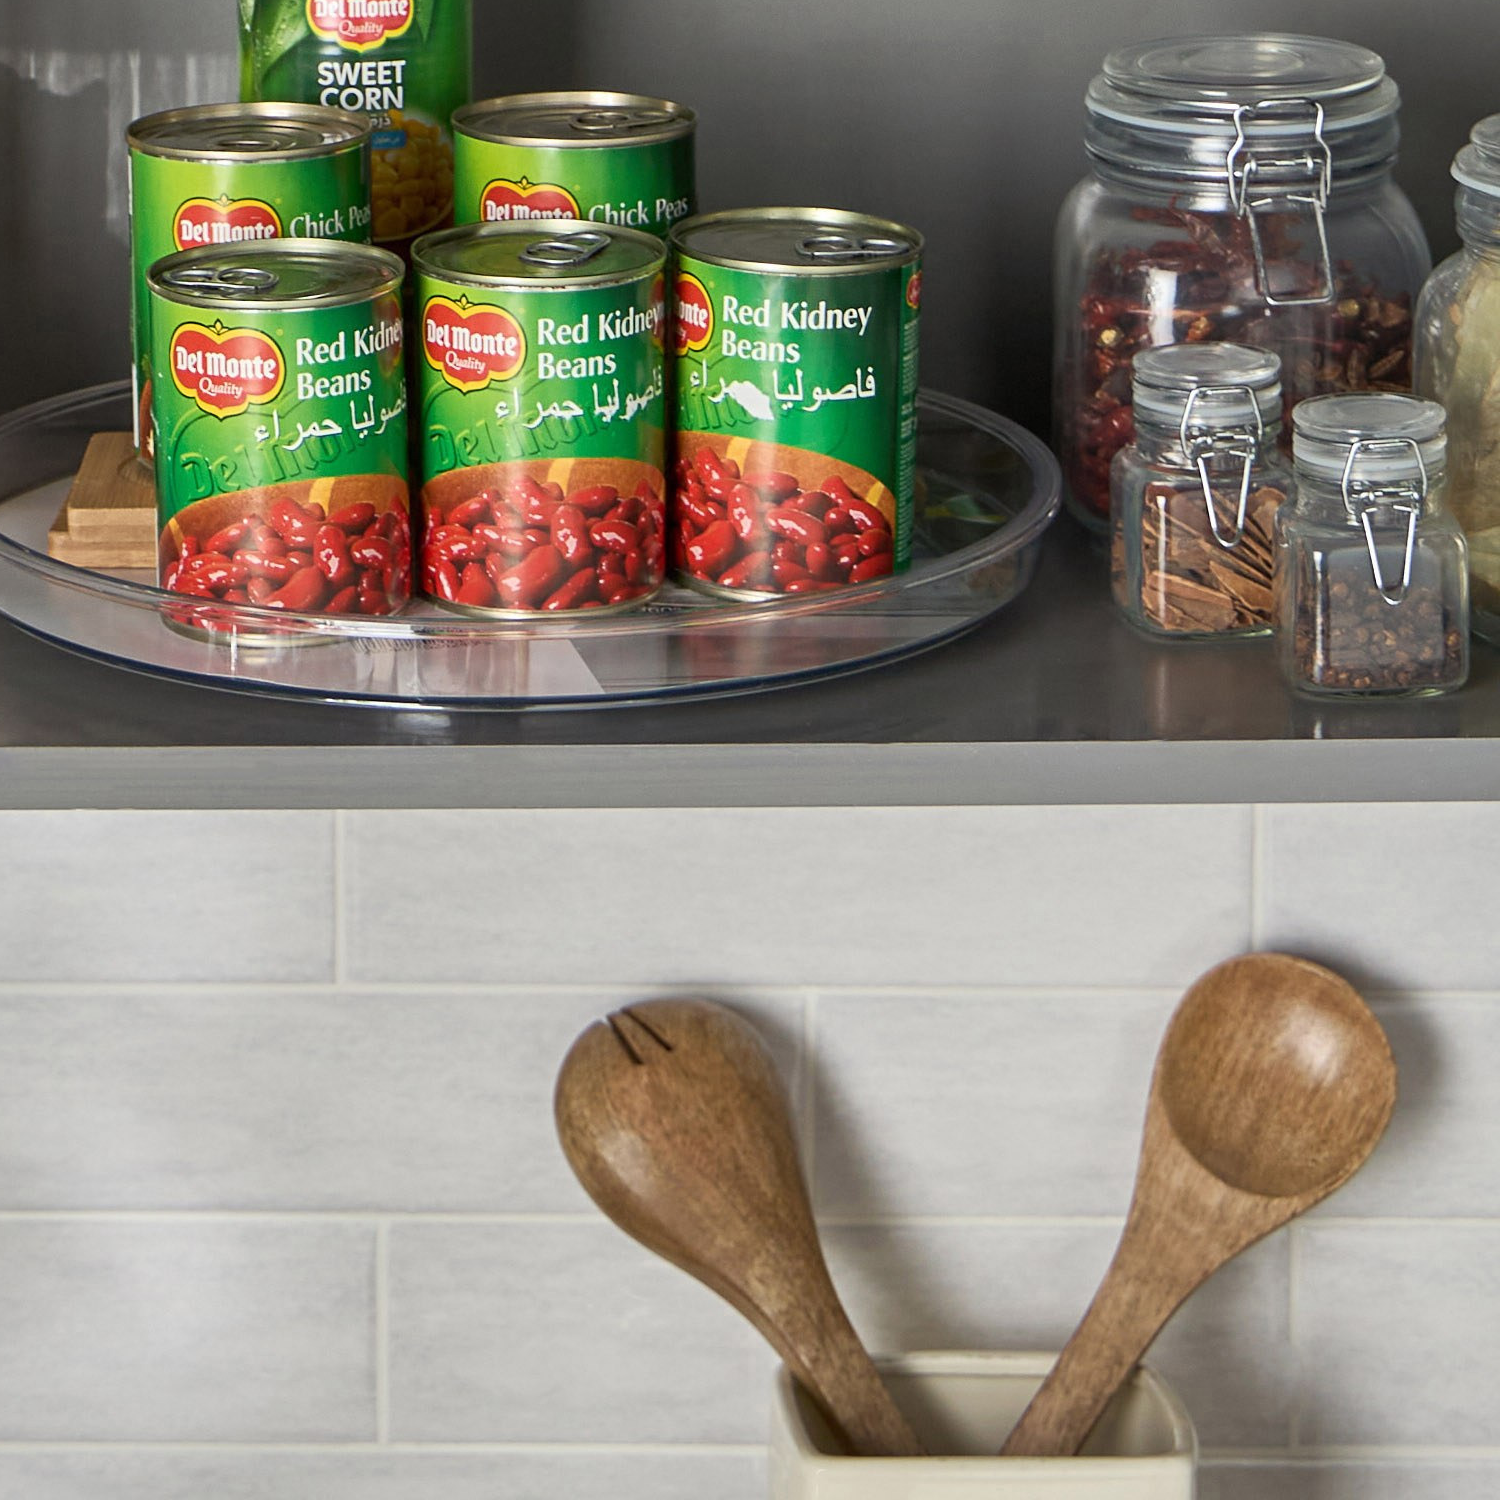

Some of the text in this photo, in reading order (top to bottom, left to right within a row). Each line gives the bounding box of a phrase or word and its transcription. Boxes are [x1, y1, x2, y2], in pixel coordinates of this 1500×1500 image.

[338, 19, 384, 37] Quality
[317, 60, 406, 86] SWEET
[320, 86, 404, 111] CORN
[289, 209, 346, 239] Chick
[485, 200, 510, 221] Del
[588, 197, 688, 226] Chick Peas
[180, 219, 276, 243] Del Monte
[537, 306, 662, 346] Red Kidney
[677, 300, 709, 329] onte
[722, 295, 873, 337] Red Kidney
[295, 330, 346, 367] Red
[426, 318, 518, 357] Del Monte
[721, 329, 802, 364] Beans
[176, 345, 277, 380] Del Monte
[445, 350, 486, 375] Quality
[537, 352, 617, 380] Beans
[198, 376, 244, 399] Quality
[297, 368, 372, 400] Beans
[772, 365, 877, 412] فاصوليا
[494, 386, 584, 430] حمراء
[254, 408, 343, 451] حمراء
